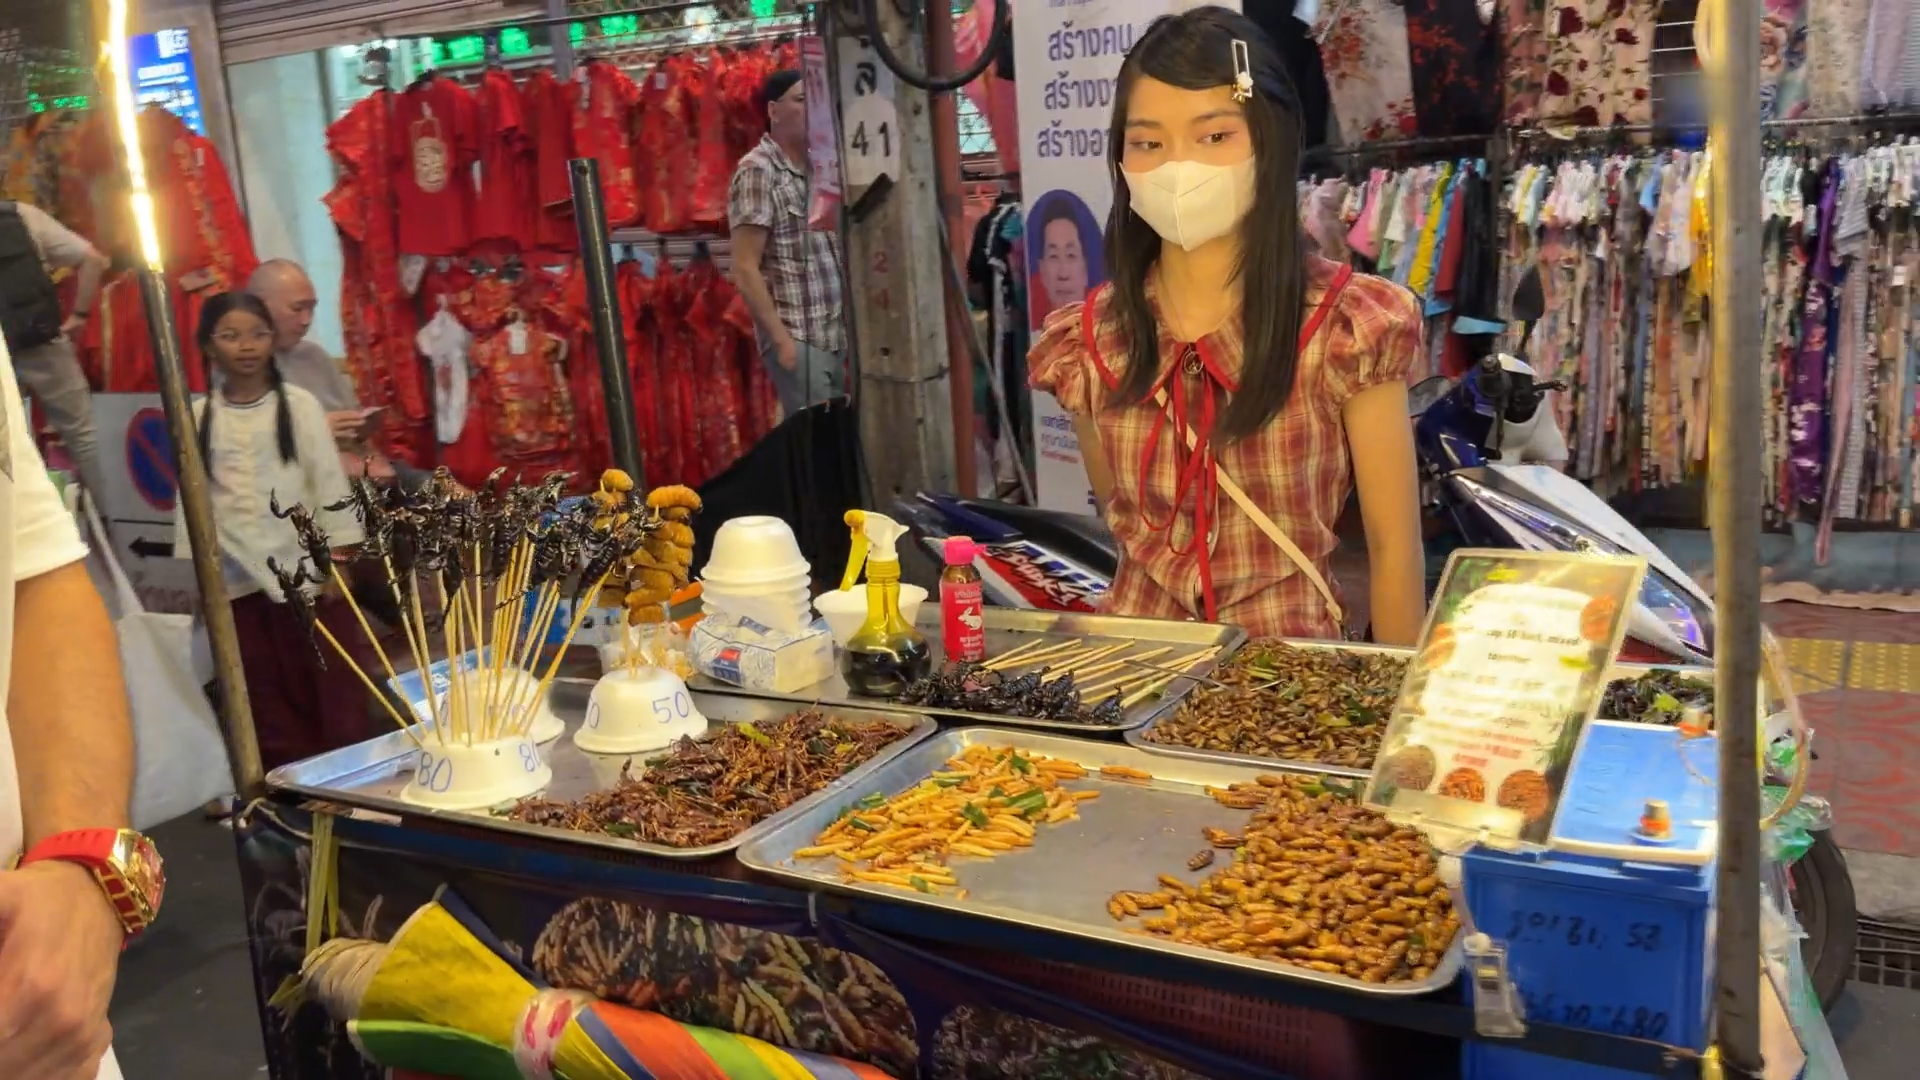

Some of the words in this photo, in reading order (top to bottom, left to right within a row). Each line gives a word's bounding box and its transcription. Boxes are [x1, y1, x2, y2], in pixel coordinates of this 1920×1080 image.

[1044, 71, 1117, 110] สร้างง
[851, 121, 891, 157] 41
[1037, 120, 1110, 158] สร้างอ
[652, 691, 690, 725] 50
[417, 751, 453, 793] 80
